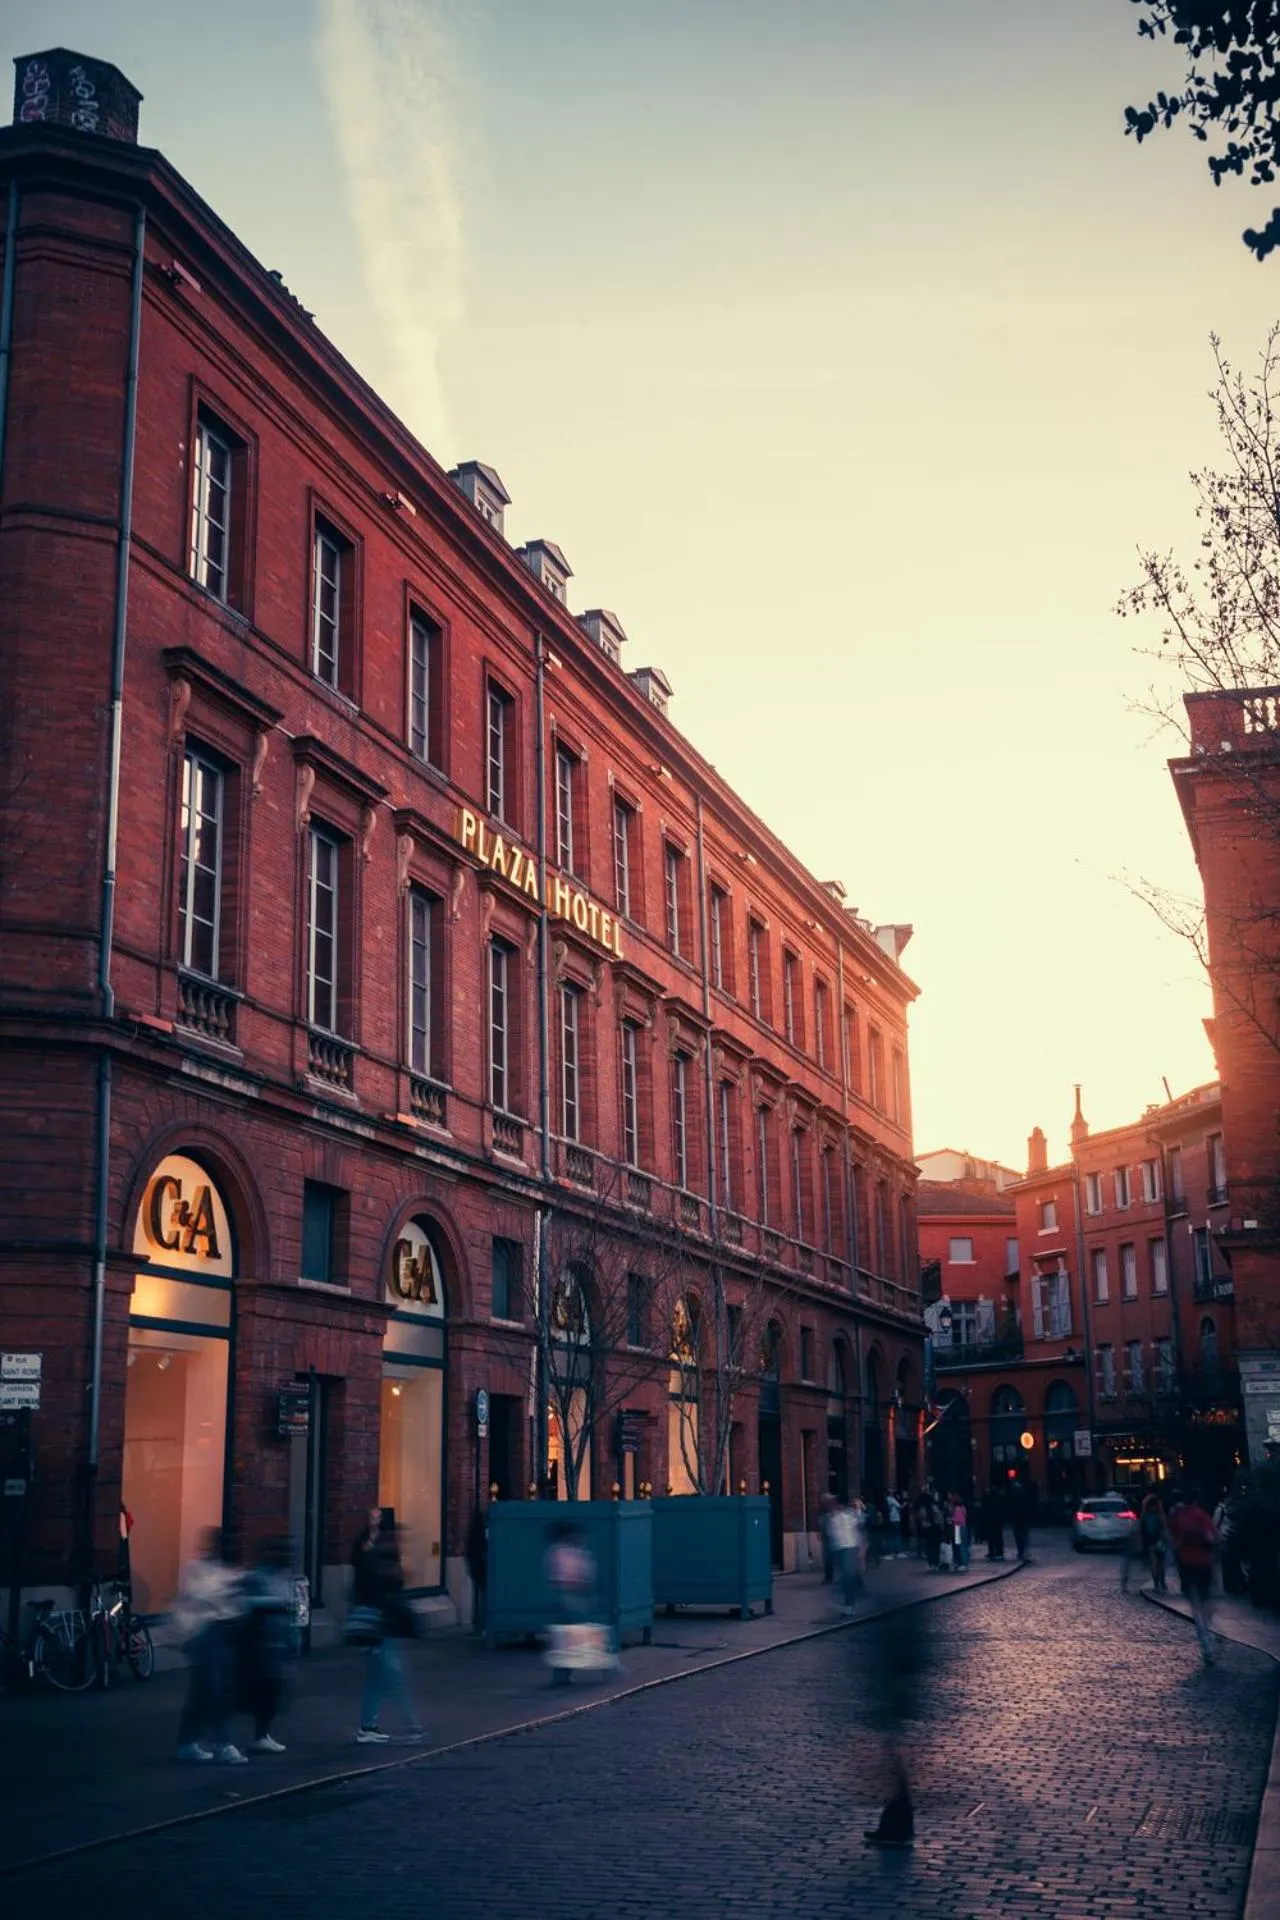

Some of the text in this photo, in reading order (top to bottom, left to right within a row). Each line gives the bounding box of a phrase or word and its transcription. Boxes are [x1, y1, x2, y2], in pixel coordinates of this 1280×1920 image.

[462, 808, 625, 959] PLAZA HOTEL
[142, 1174, 222, 1260] C&A
[389, 1238, 438, 1305] C&A
